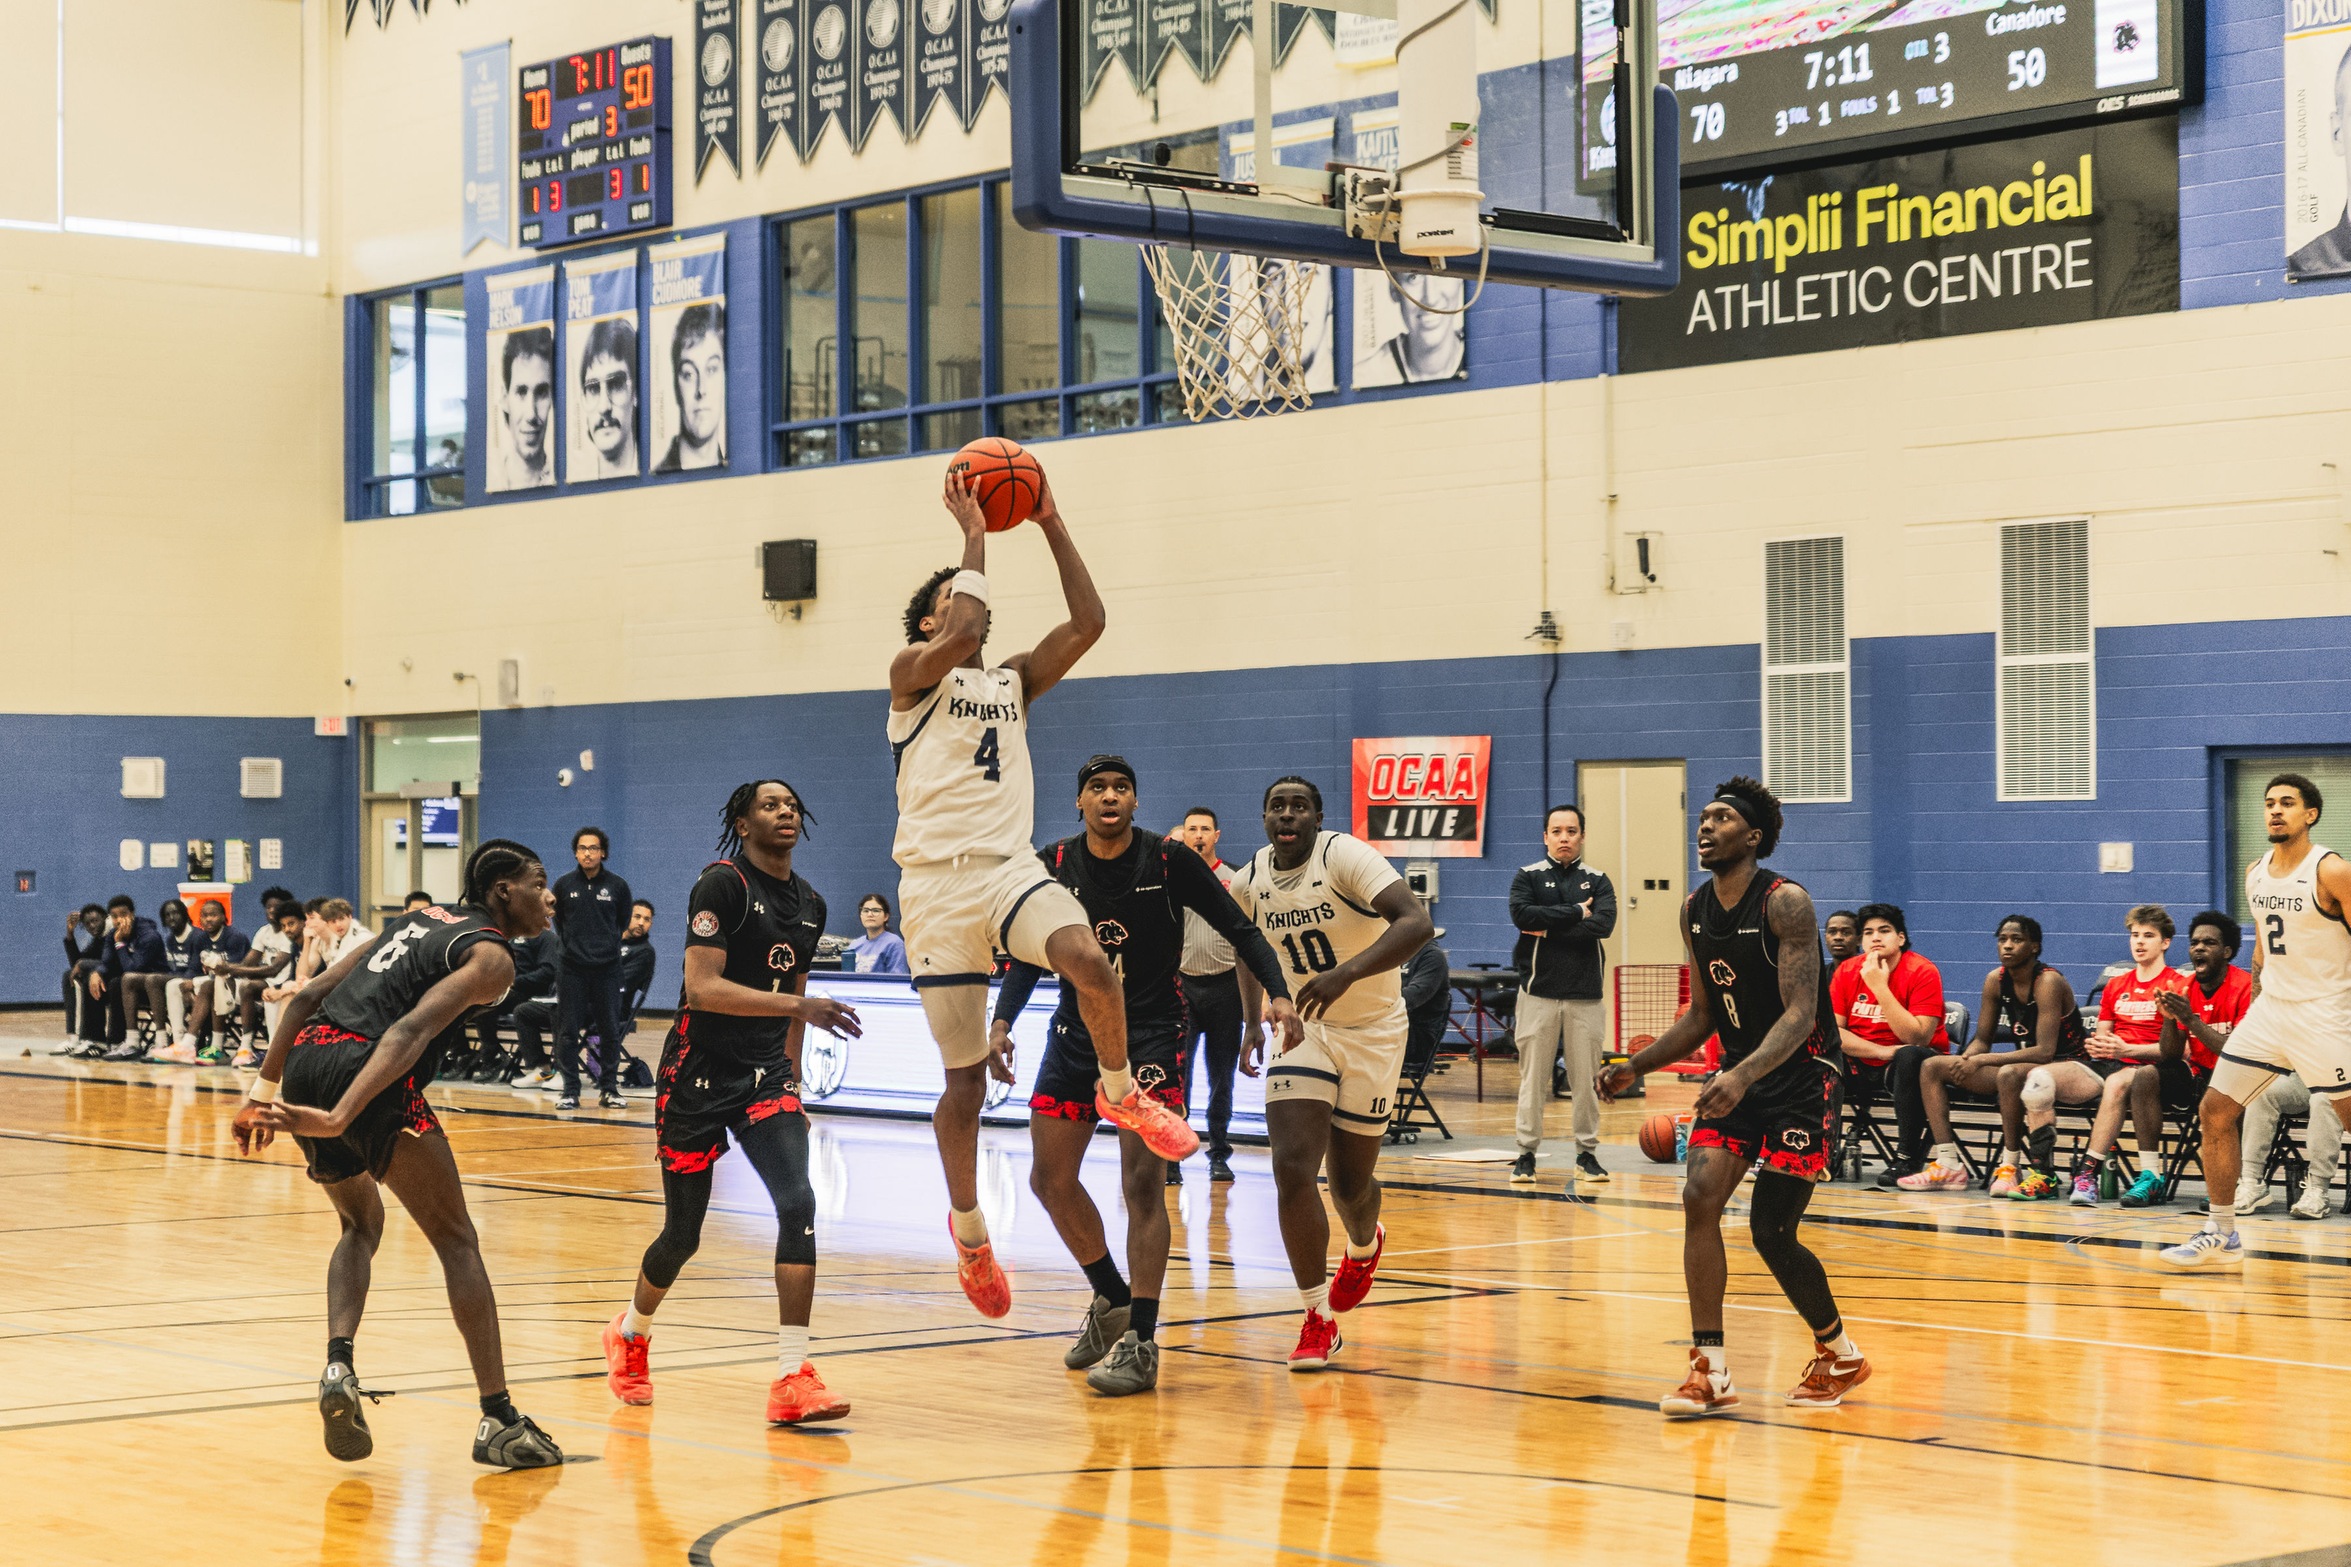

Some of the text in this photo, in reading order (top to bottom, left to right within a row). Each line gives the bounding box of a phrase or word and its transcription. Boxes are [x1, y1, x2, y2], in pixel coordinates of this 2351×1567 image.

[1985, 4, 2067, 36] Canadore
[1934, 31, 1951, 63] 3
[569, 49, 615, 94] 7:11
[1674, 63, 1739, 92] Niagara
[1804, 42, 1873, 90] 7:11
[2007, 47, 2046, 91] 50
[623, 64, 654, 110] 50
[524, 89, 551, 130] 70
[605, 105, 618, 138] 3
[1690, 102, 1725, 143] 70
[1775, 110, 1788, 136] 3
[1818, 101, 1831, 126] 1
[1887, 90, 1902, 115] 1
[1940, 82, 1954, 108] 3
[609, 167, 623, 200] 3
[641, 163, 649, 192] 1
[532, 186, 540, 213] 1
[549, 181, 562, 212] 3
[2309, 193, 2319, 223] GOLF
[1686, 154, 2094, 273] Simplii Financial
[1417, 229, 1454, 240] porter
[1686, 238, 2094, 332] ATHLETIC CENTRE
[974, 727, 1001, 783] 4
[1367, 754, 1478, 801] OCAA
[1384, 809, 1460, 837] LIVE
[1264, 902, 1336, 931] KNIGHTS
[2252, 894, 2303, 912] KNIGHTS
[1281, 928, 1338, 975] 10
[2265, 914, 2287, 956] 2
[2335, 1067, 2347, 1082] 2
[1370, 1096, 1387, 1114] 10
